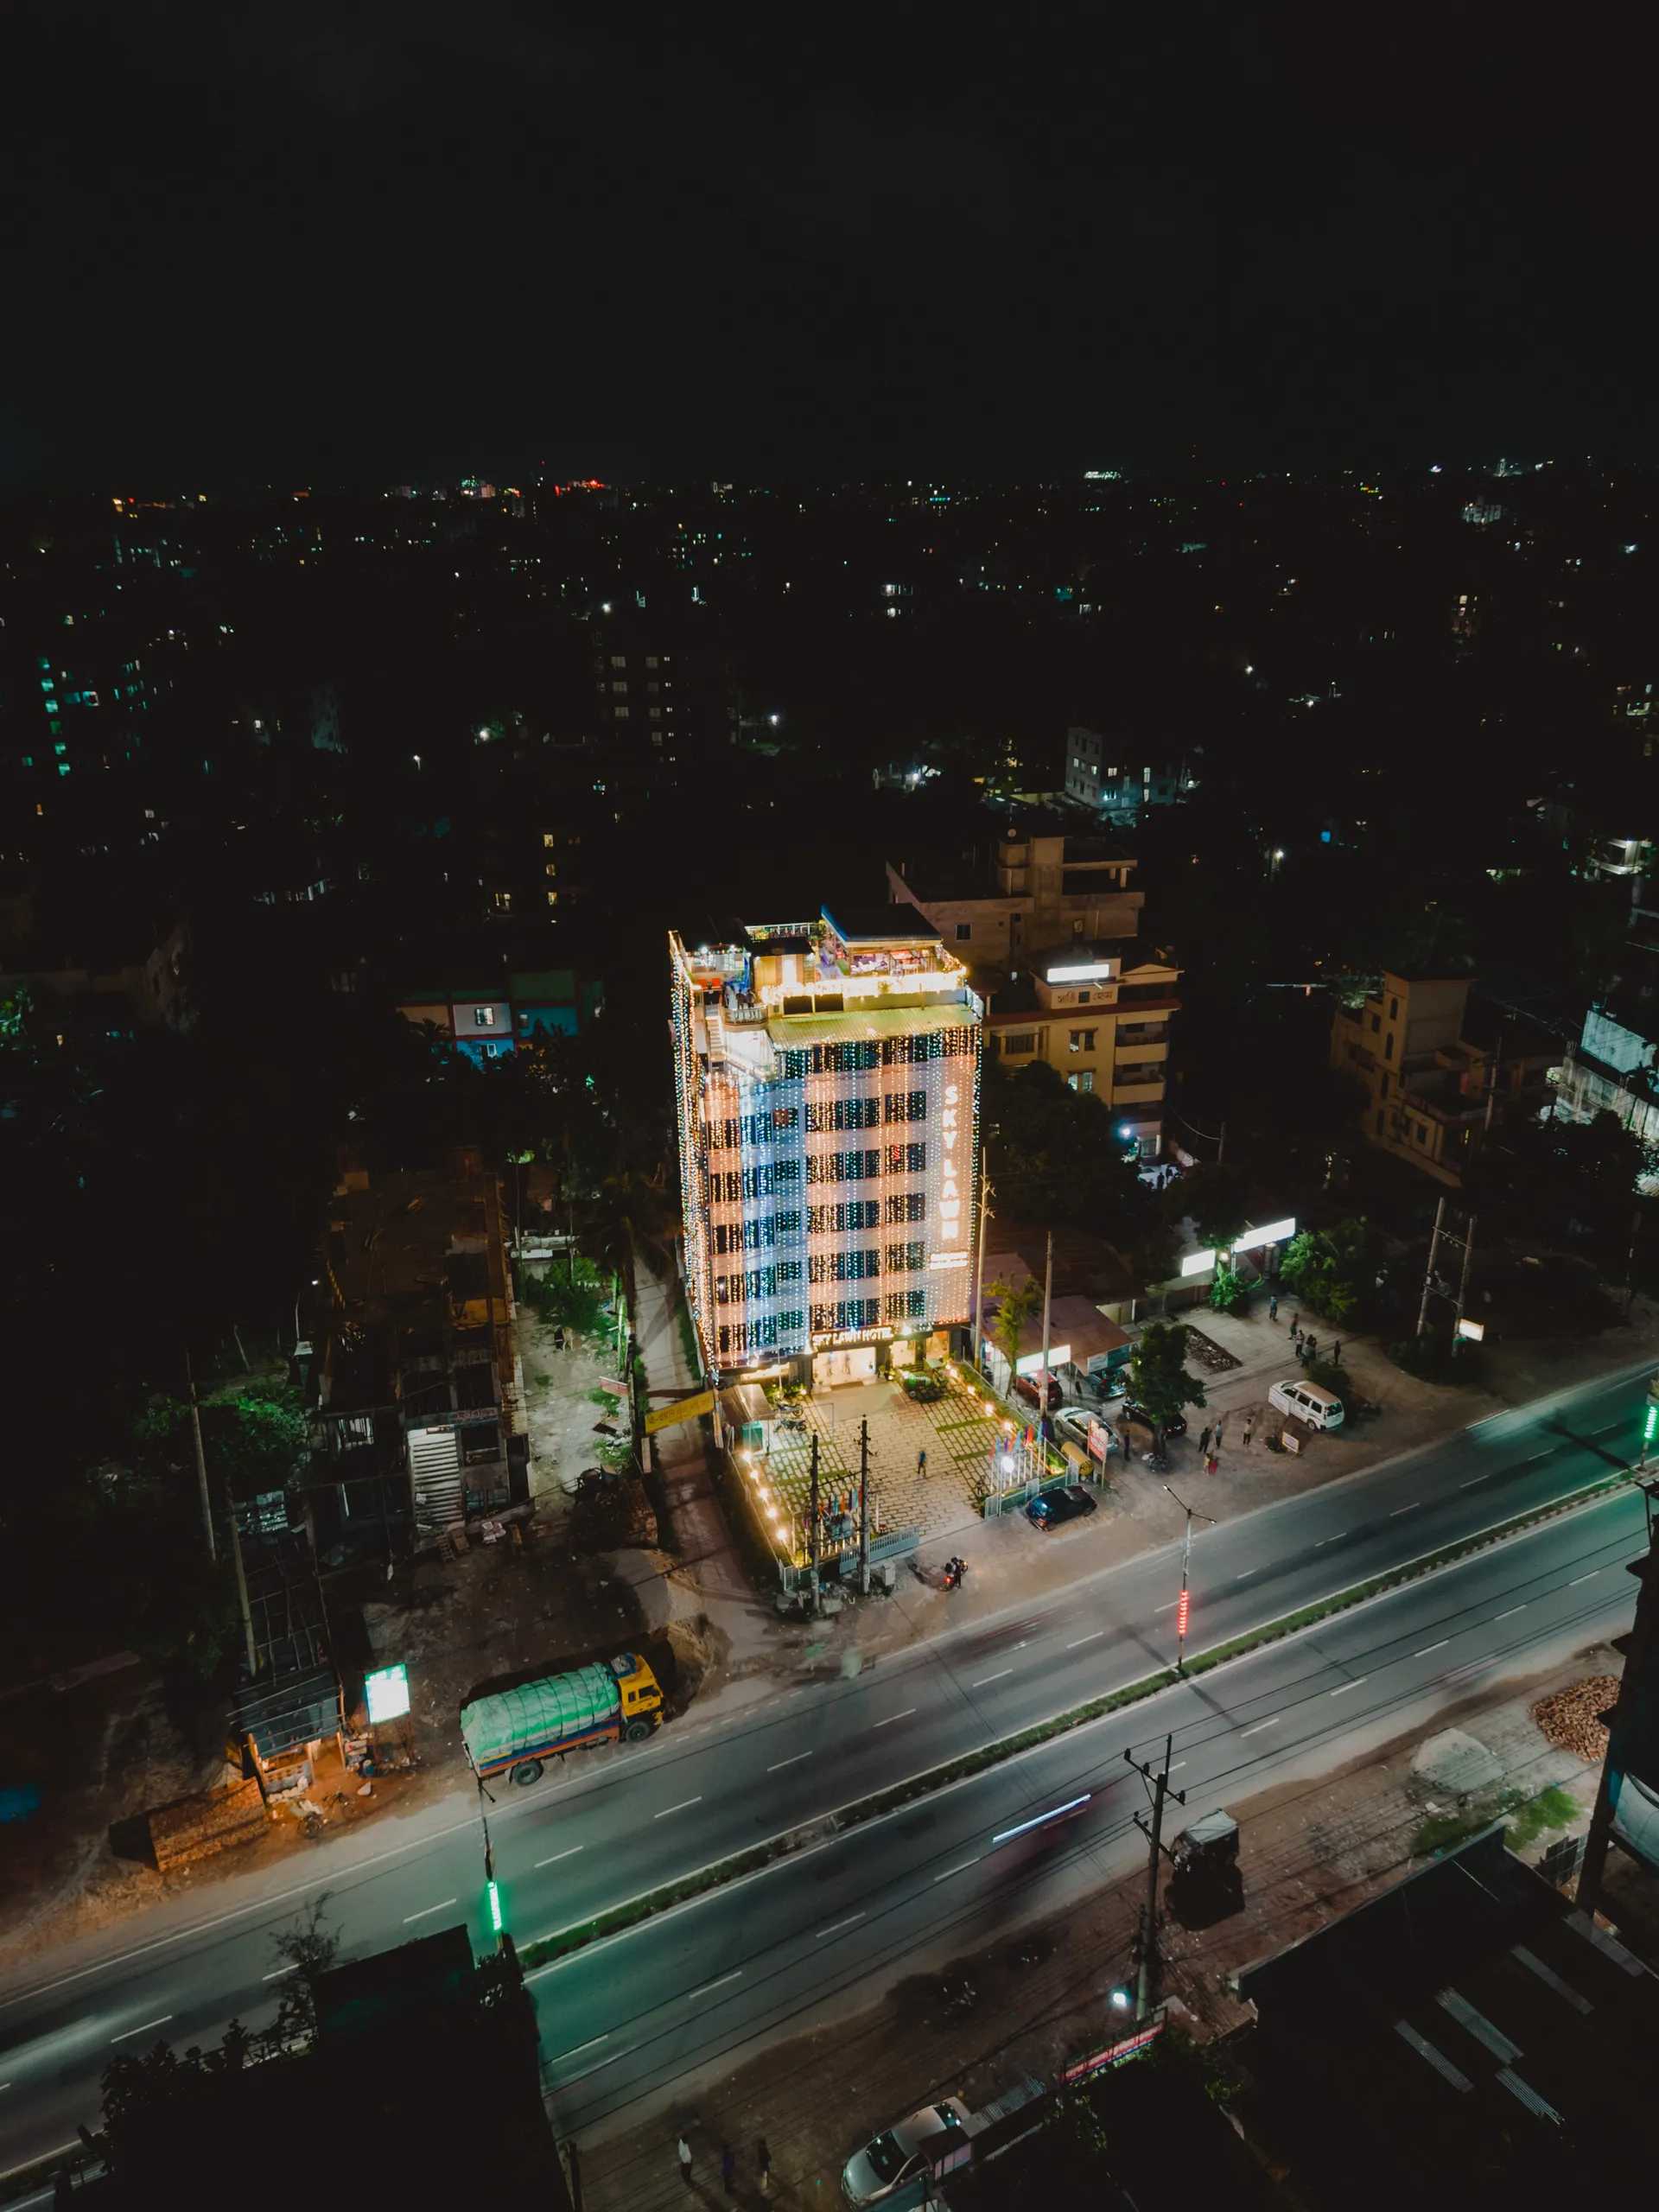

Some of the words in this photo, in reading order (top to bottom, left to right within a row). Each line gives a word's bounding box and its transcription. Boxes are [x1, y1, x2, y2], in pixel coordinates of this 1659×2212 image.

[943, 1085, 958, 1148] SKY
[939, 1159, 960, 1239] LAWN
[812, 1333, 831, 1346] SKY
[862, 1327, 893, 1341] HOTEL
